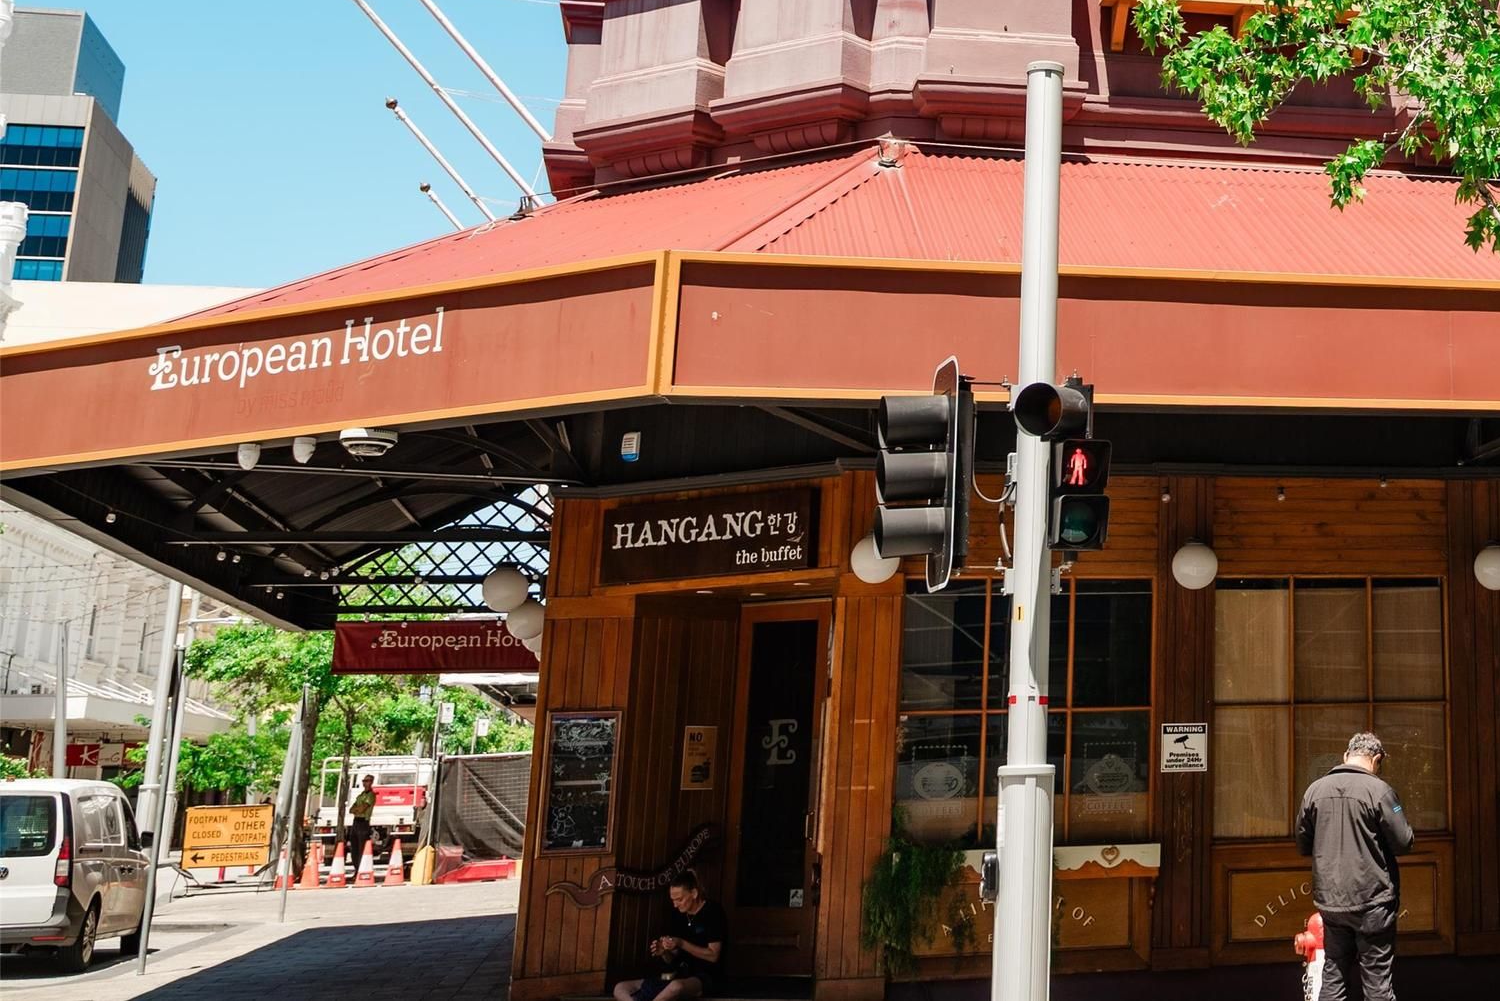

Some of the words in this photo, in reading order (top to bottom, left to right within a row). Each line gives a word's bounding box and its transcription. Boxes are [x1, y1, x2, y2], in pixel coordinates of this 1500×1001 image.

[148, 336, 332, 391] European
[340, 306, 445, 365] Hotel
[612, 510, 765, 549] HANGANG
[767, 512, 799, 536] 한강
[735, 549, 758, 566] the
[762, 545, 803, 564] buffet
[378, 629, 481, 652] European
[485, 630, 525, 647] Hot
[189, 815, 228, 824] FOOTPATH
[241, 809, 260, 819] USE
[192, 830, 221, 839] CLOSED
[234, 821, 266, 831] OTHER
[230, 832, 267, 843] FOOTPATH
[210, 851, 260, 862] PEDESTRIANS
[599, 875, 613, 891] A
[616, 873, 656, 891] TOUCH
[657, 868, 673, 886] OF
[674, 828, 711, 872] EUROPE
[1072, 906, 1096, 927] OF
